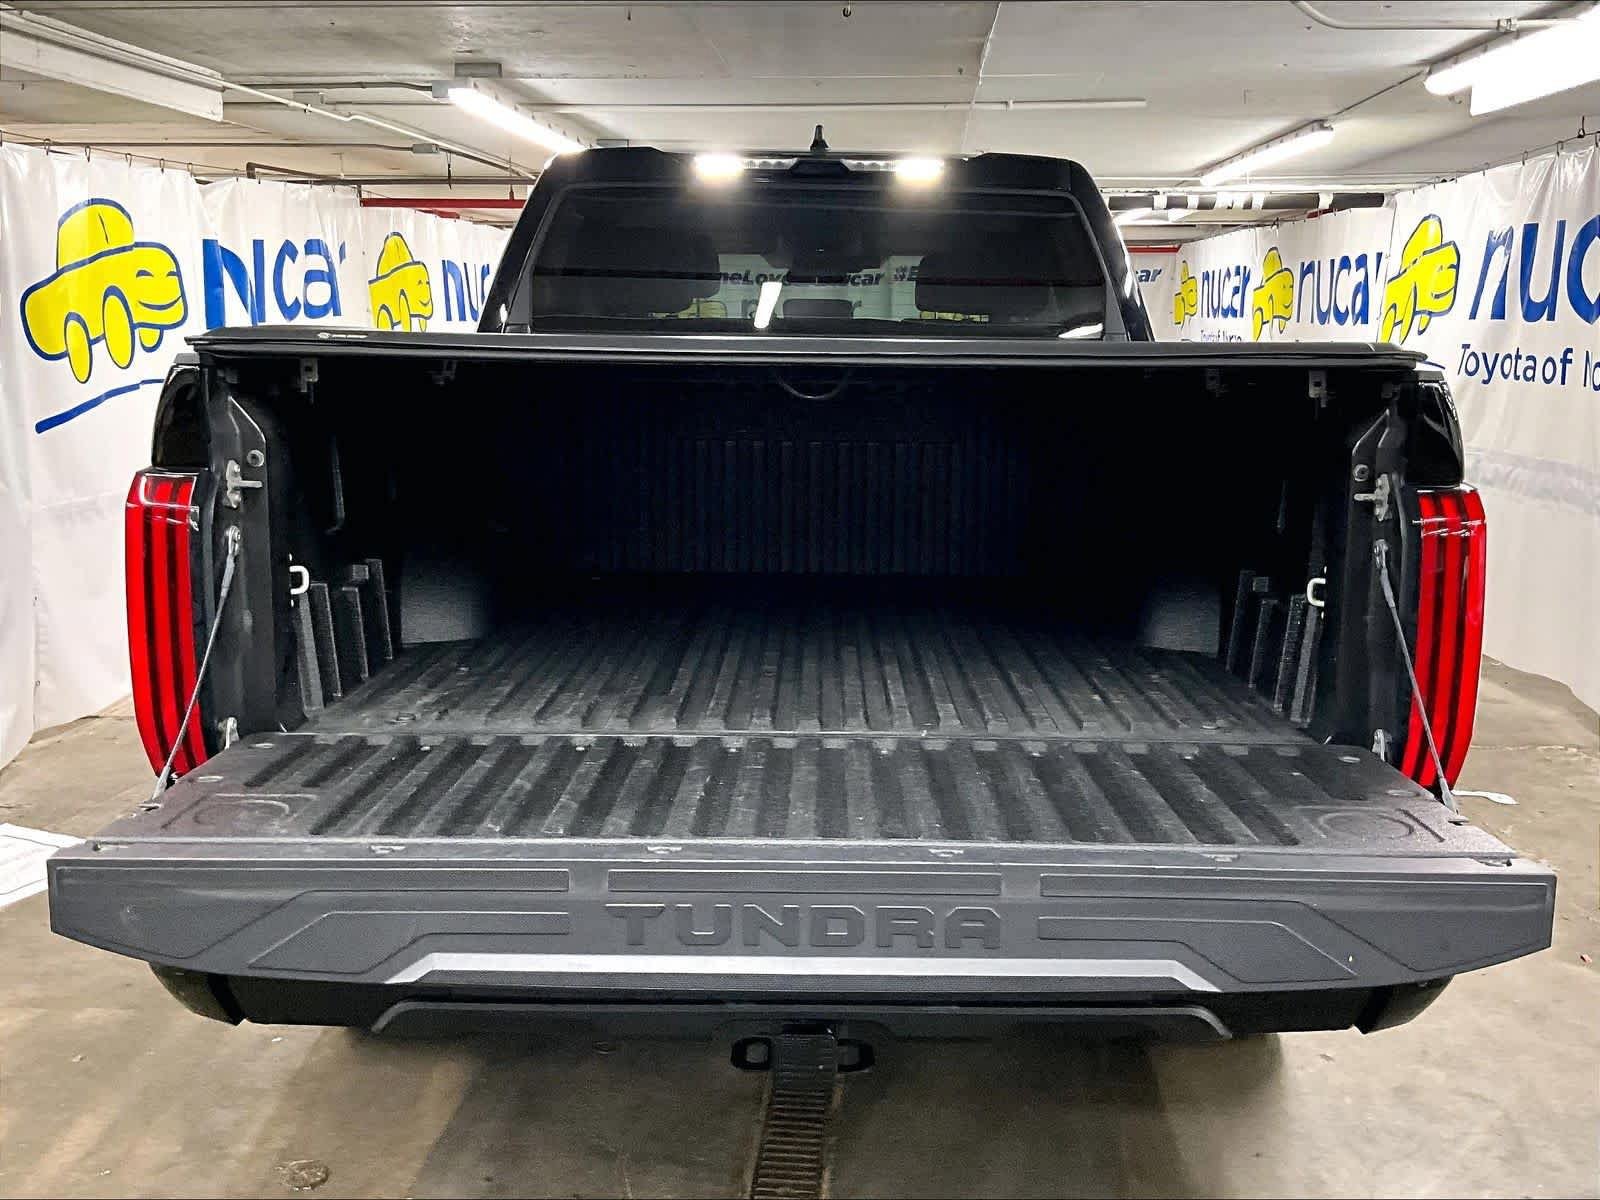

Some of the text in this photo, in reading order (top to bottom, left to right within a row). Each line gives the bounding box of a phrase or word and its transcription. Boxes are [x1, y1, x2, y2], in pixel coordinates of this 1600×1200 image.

[202, 238, 346, 330] nuca
[1136, 268, 1162, 283] ar
[1201, 265, 1251, 319] nucar
[1458, 343, 1537, 385] Toyota
[1542, 347, 1573, 386] of
[605, 903, 1001, 949] TUNDRA
